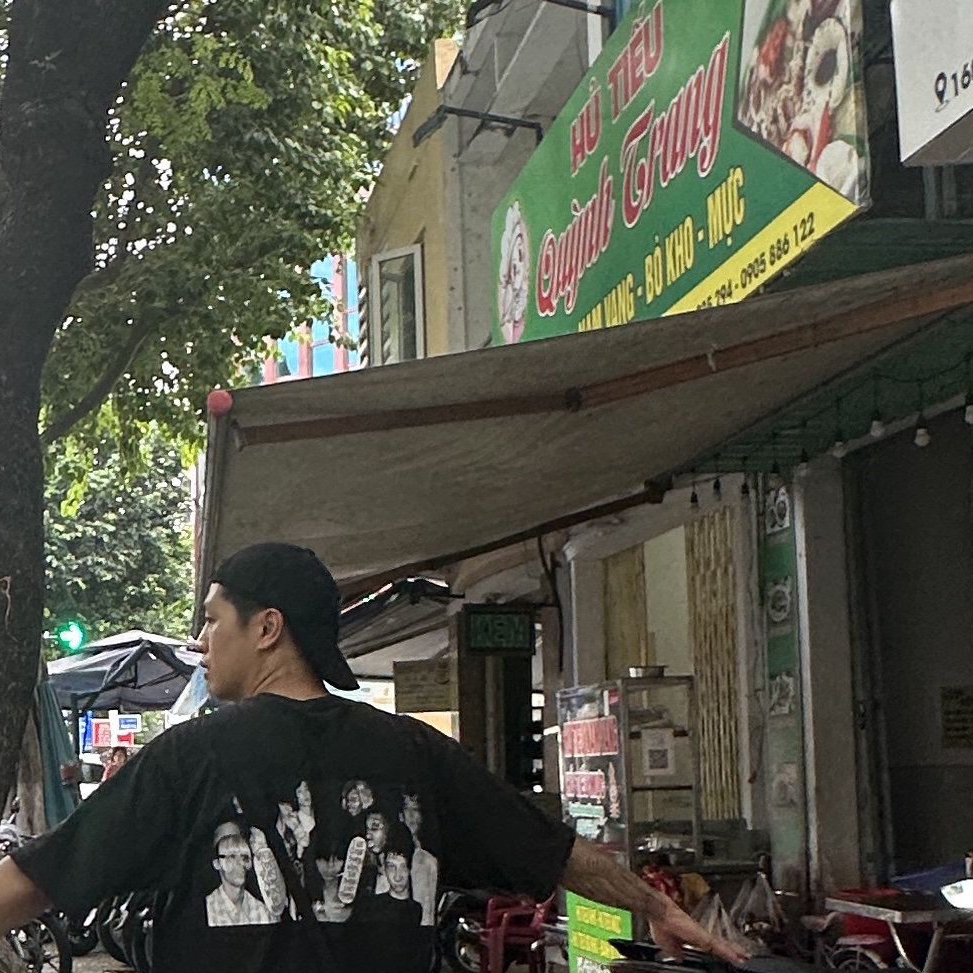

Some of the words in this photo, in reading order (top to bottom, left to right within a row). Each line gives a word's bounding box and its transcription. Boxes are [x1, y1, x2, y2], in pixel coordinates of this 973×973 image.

[951, 58, 973, 96] 16
[620, 30, 731, 228] Trung
[665, 215, 695, 286] KHO
[707, 166, 745, 249] MỰC
[740, 252, 767, 289] 0905
[793, 212, 816, 247] 122
